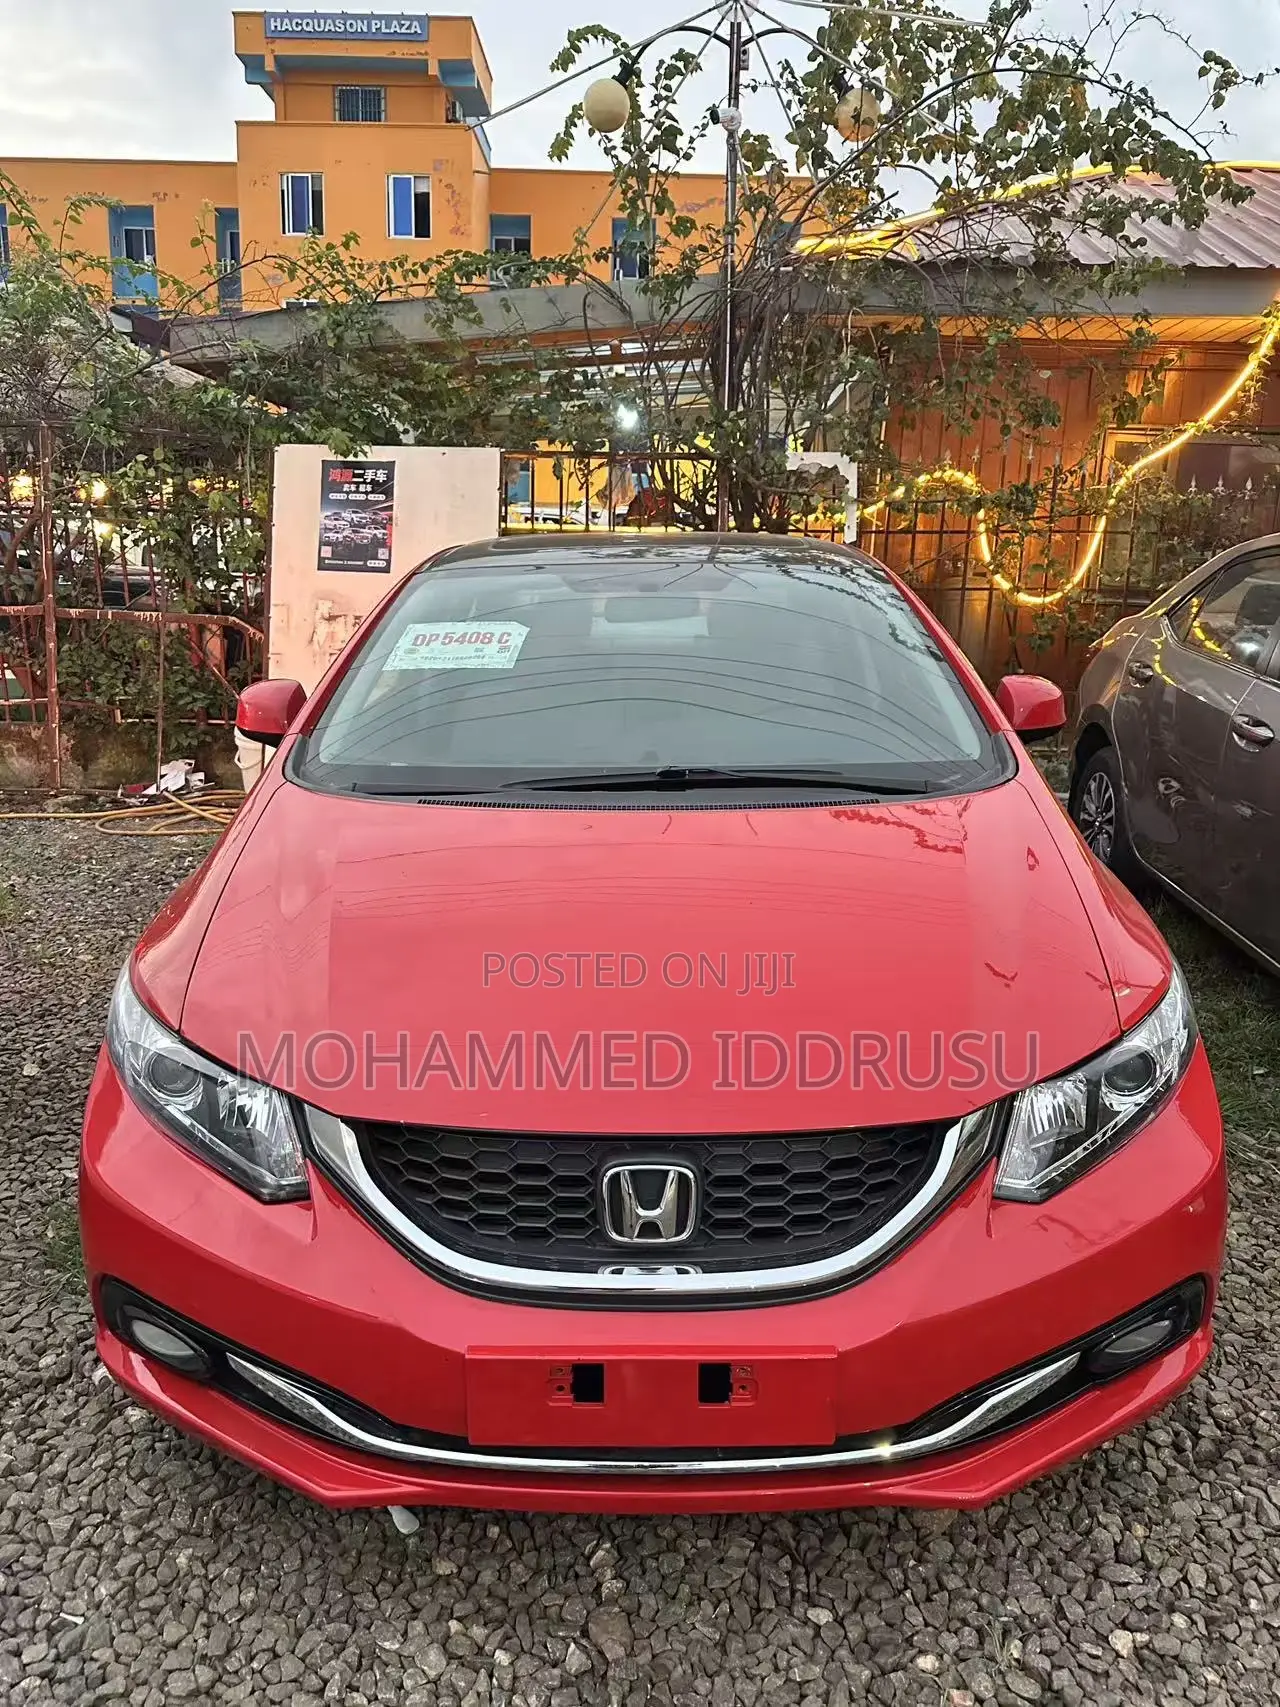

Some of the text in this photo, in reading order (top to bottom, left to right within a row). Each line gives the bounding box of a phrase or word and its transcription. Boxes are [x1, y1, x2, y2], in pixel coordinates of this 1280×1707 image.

[270, 17, 422, 34] HACQUASON PLAZA
[441, 632, 495, 646] 5408
[498, 632, 512, 645] C
